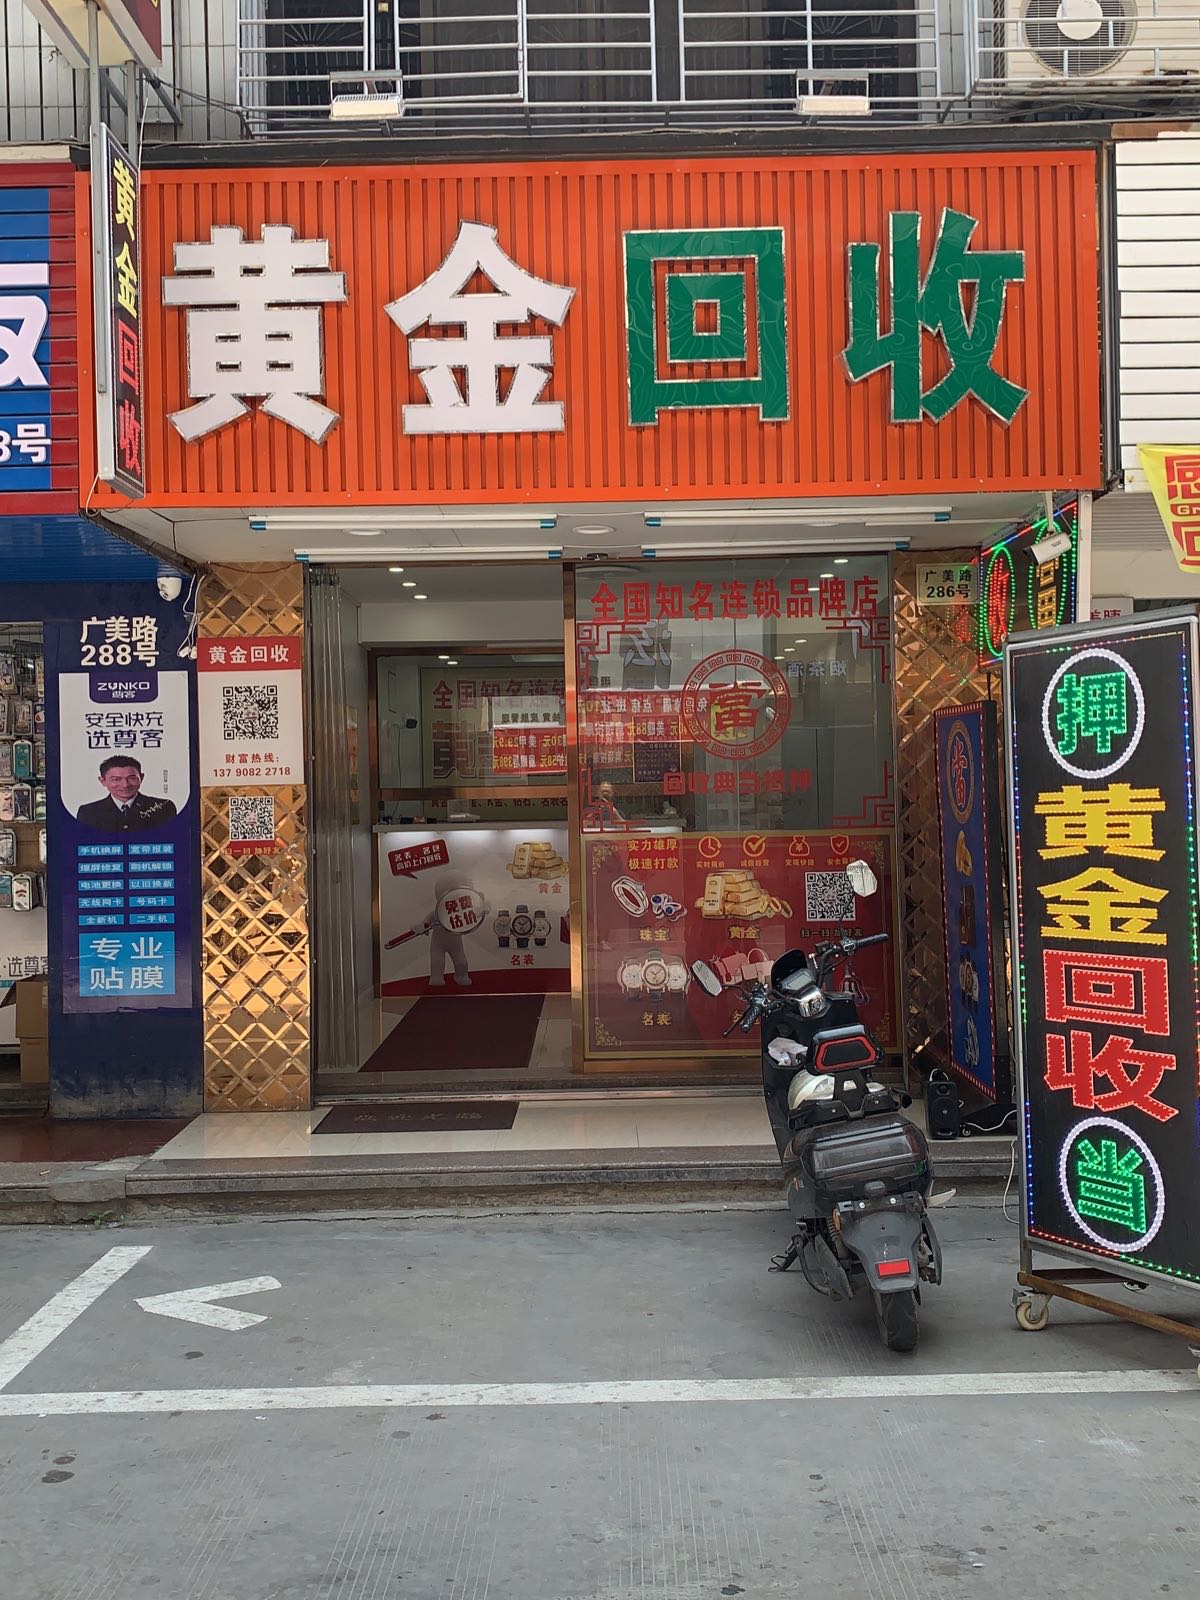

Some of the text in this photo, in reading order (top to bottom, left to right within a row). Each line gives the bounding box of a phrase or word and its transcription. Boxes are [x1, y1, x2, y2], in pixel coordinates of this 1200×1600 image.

[112, 157, 142, 476] 黄金回收
[162, 207, 1031, 447] 黄金回收
[925, 569, 972, 583] 广美路
[591, 576, 878, 622] 全国知名连锁品牌店
[926, 584, 971, 599] 286号
[80, 616, 158, 643] 广美路
[80, 643, 159, 667] 288号
[208, 645, 290, 665] 黄金回收
[85, 710, 164, 728] 安全快充
[1057, 671, 1128, 755] 押
[87, 729, 164, 749] 选尊客
[213, 766, 291, 778] 137 9082 2718
[80, 846, 121, 854] 手机换屏
[627, 837, 679, 852] 实力雄厚
[627, 857, 679, 871] 极速打款
[80, 879, 172, 889] 电池更换 以旧换新
[537, 882, 562, 894] 黄金
[80, 897, 167, 907] 无线网卡 号码卡
[86, 914, 168, 924] 全新机 二手机
[449, 910, 478, 929] 估价
[639, 927, 669, 942] 珠宝
[728, 926, 760, 940] 黄金
[801, 928, 830, 938] 扫一扫
[90, 936, 164, 960] 专业
[1034, 782, 1180, 1123] 黄金回收
[510, 953, 535, 966] 名表
[90, 966, 164, 990] 贴膜
[641, 1011, 672, 1026] 名表
[1077, 1138, 1148, 1234] 当
